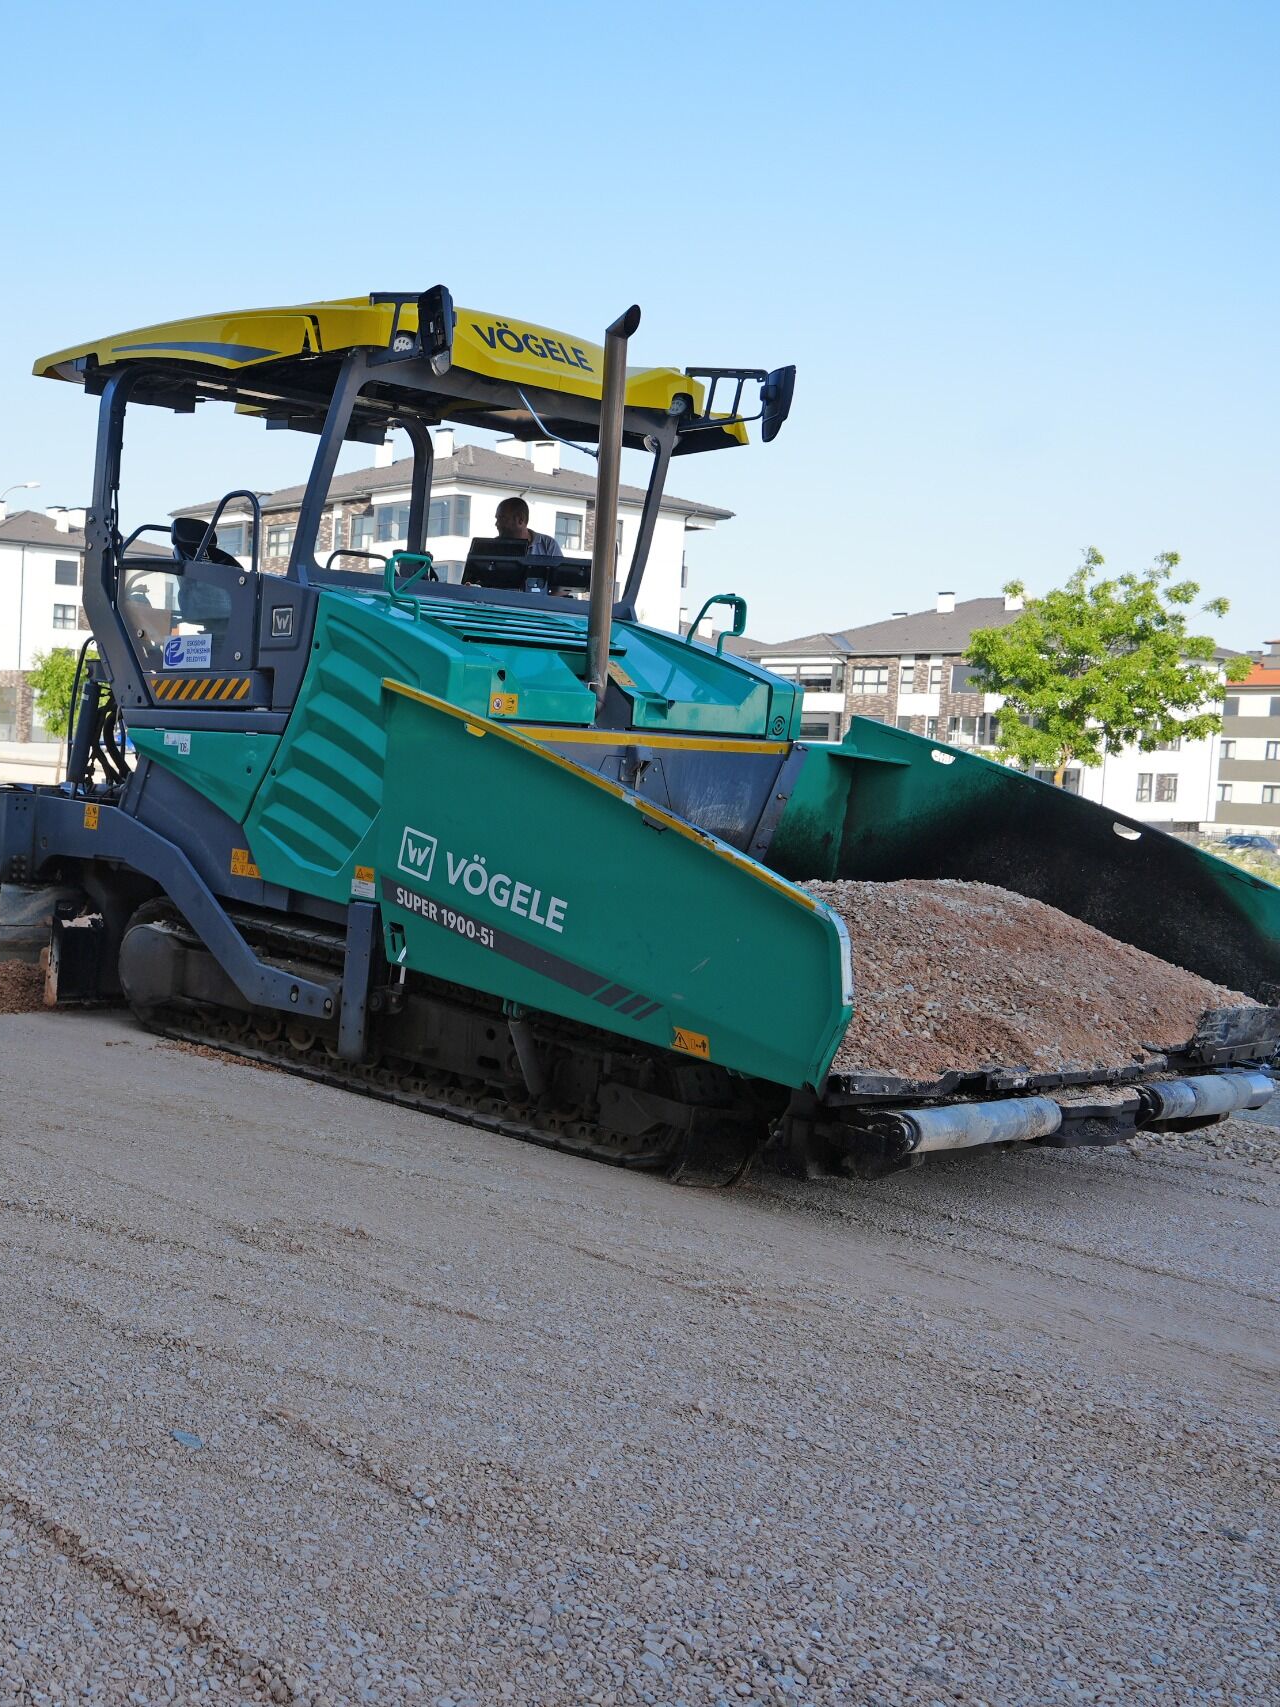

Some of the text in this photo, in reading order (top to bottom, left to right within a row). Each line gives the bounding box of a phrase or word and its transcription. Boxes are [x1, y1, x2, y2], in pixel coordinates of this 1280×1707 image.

[471, 321, 594, 372] VÖGELE
[396, 887, 437, 921] SUPER
[441, 908, 494, 948] 1900-5i
[446, 851, 568, 933] VÖGELE
